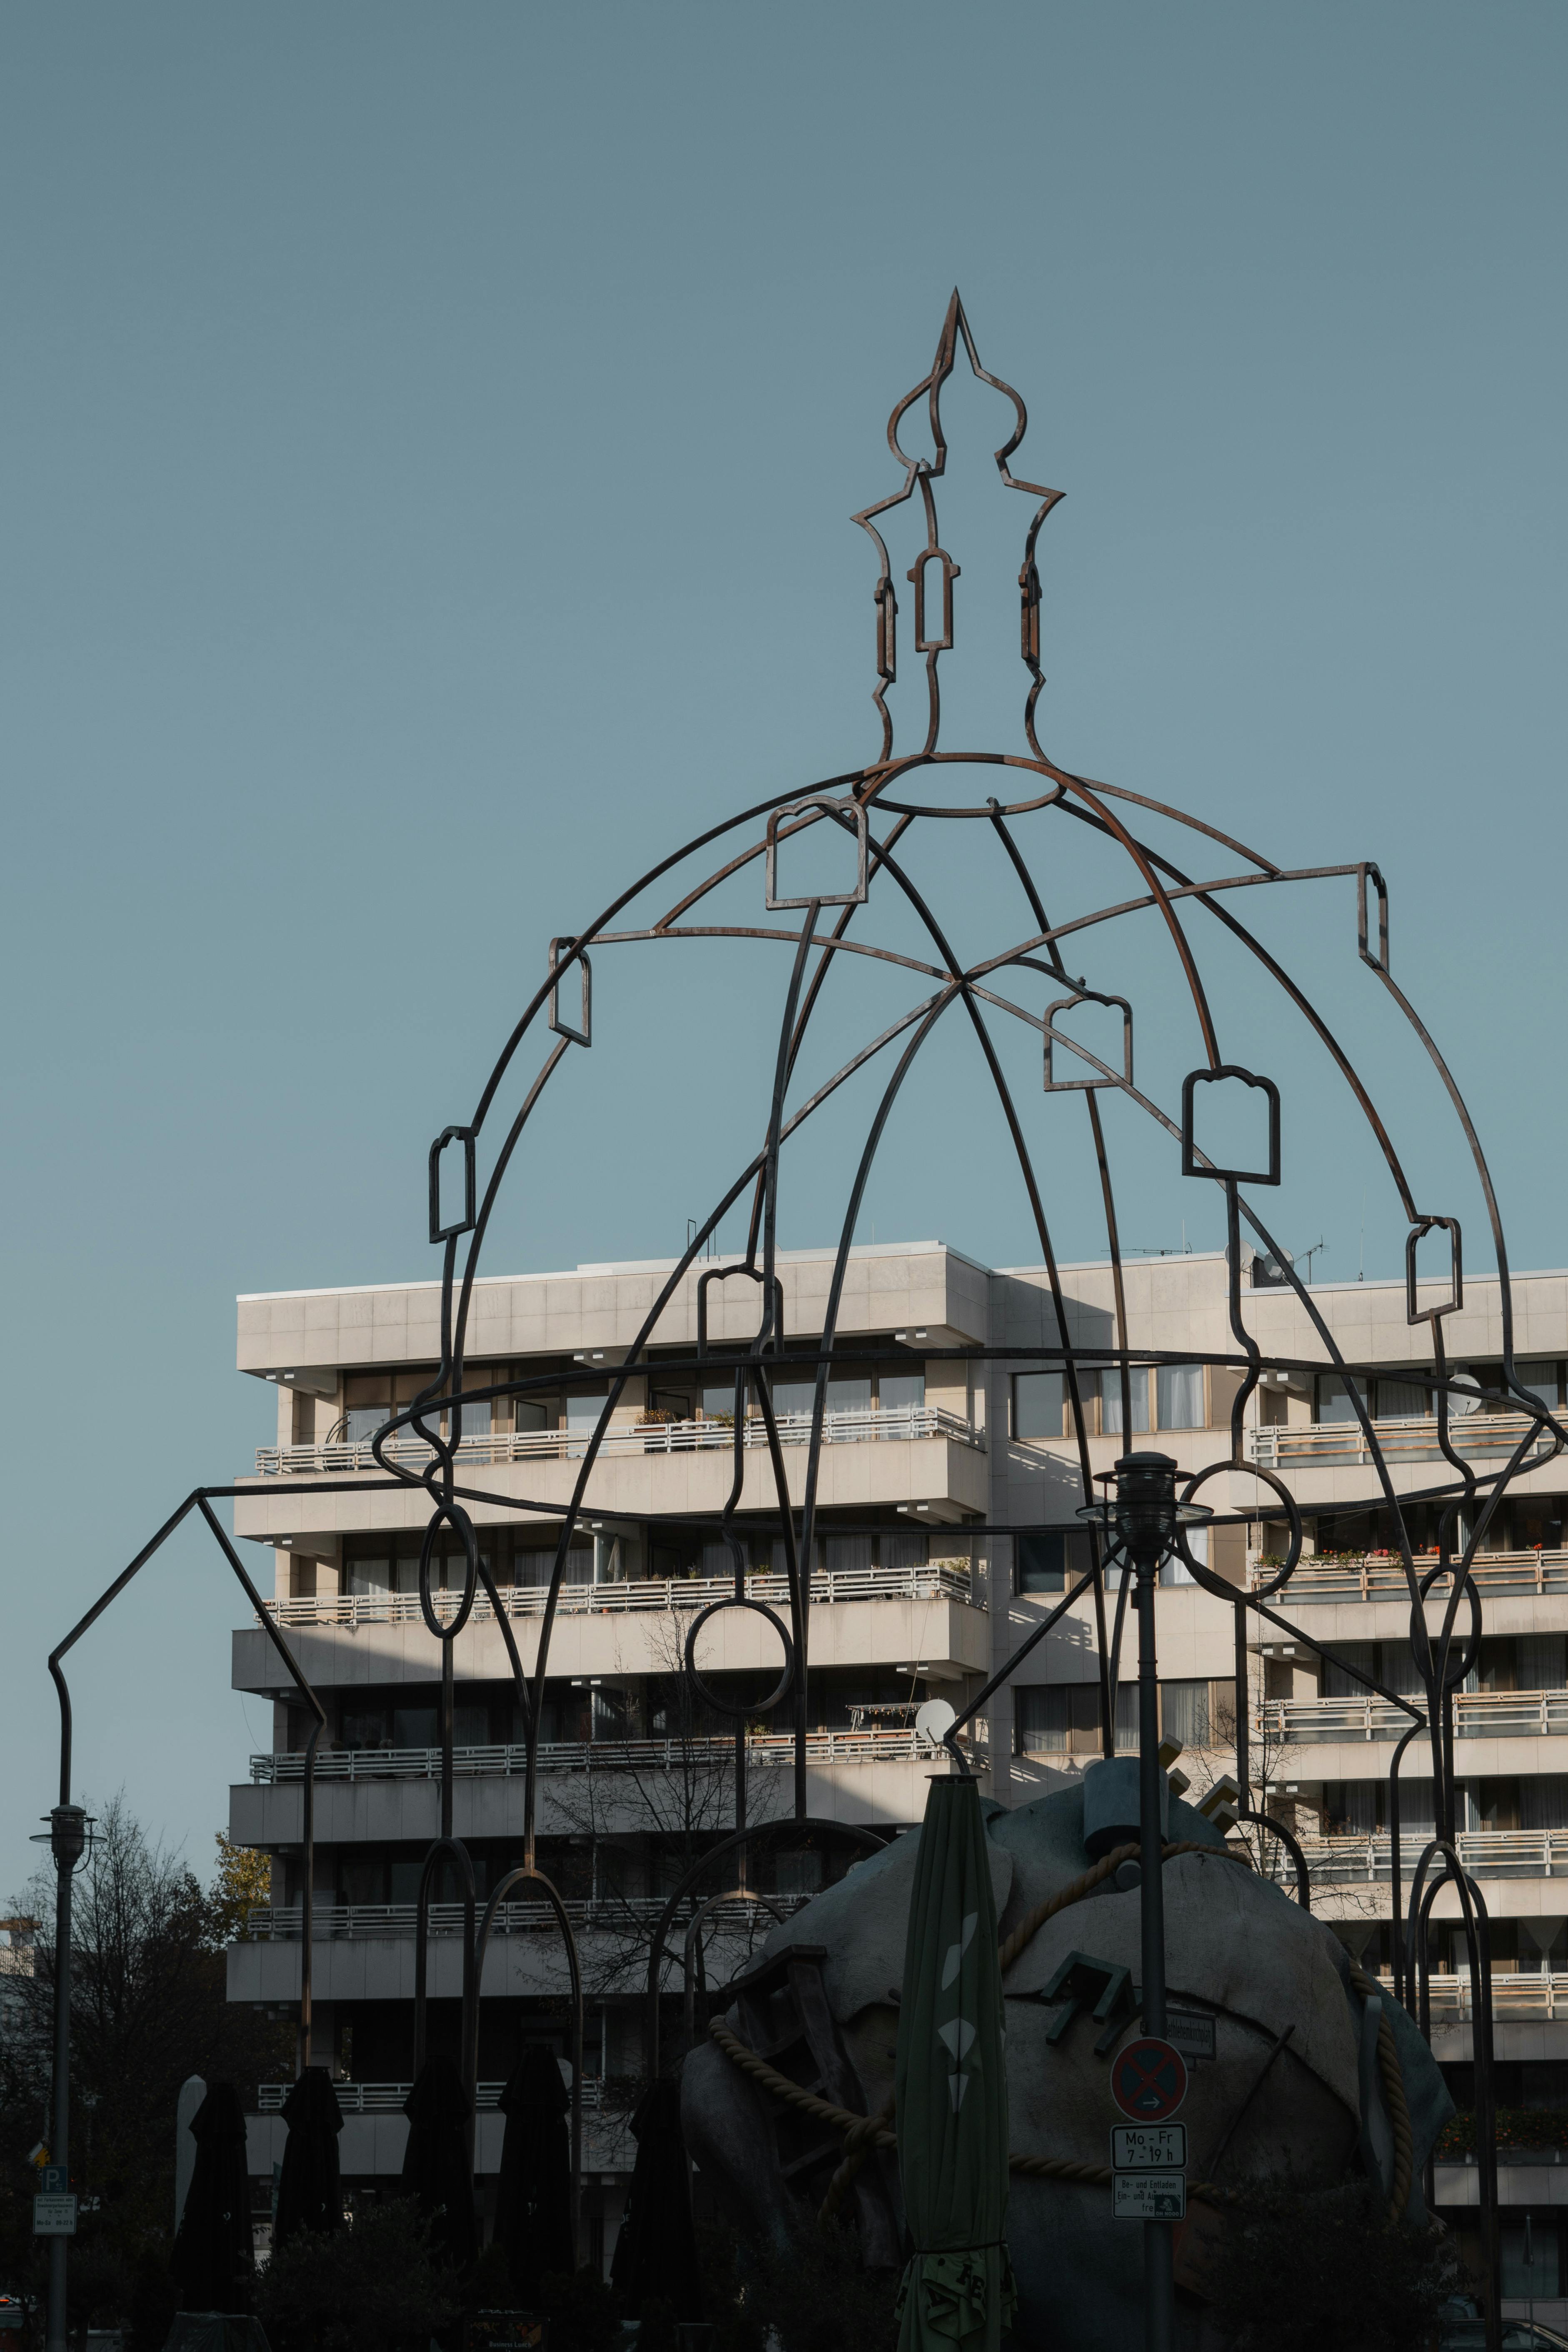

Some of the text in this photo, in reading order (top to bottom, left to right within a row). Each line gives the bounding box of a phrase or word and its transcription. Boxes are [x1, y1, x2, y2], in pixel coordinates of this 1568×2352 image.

[1126, 2132, 1144, 2145] Mo
[1159, 2131, 1173, 2144] Fr
[1128, 2150, 1135, 2162] 7
[1150, 2148, 1161, 2162] 19
[1167, 2148, 1173, 2161] h
[47, 2170, 60, 2190] P
[1122, 2180, 1133, 2188] Be-
[1150, 2180, 1176, 2189] Entladen
[1118, 2192, 1131, 2200] Ein-
[1142, 2203, 1154, 2212] fre
